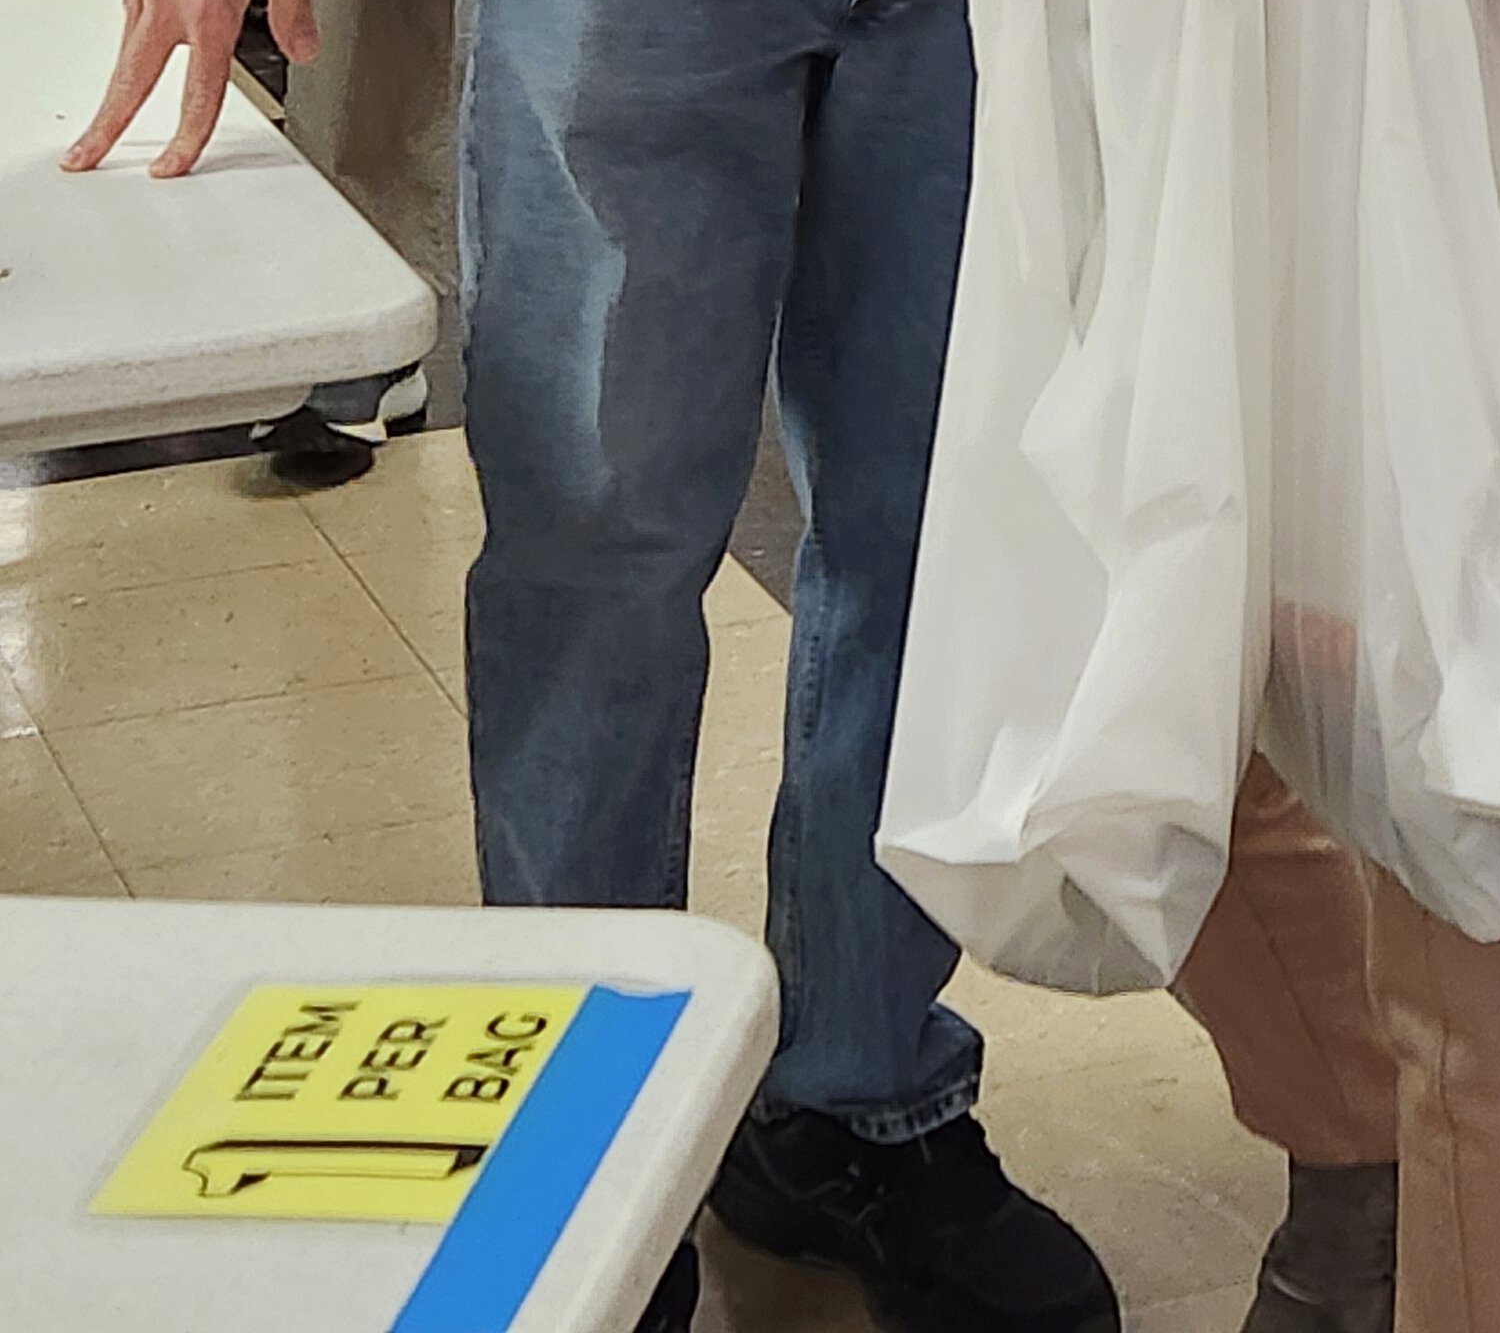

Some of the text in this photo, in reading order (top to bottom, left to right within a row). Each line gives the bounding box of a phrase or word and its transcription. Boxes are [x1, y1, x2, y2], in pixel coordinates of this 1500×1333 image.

[233, 1000, 362, 1102] ITEM
[336, 1016, 450, 1101] PER
[439, 1012, 551, 1104] BAG
[181, 1138, 490, 1199] 1
